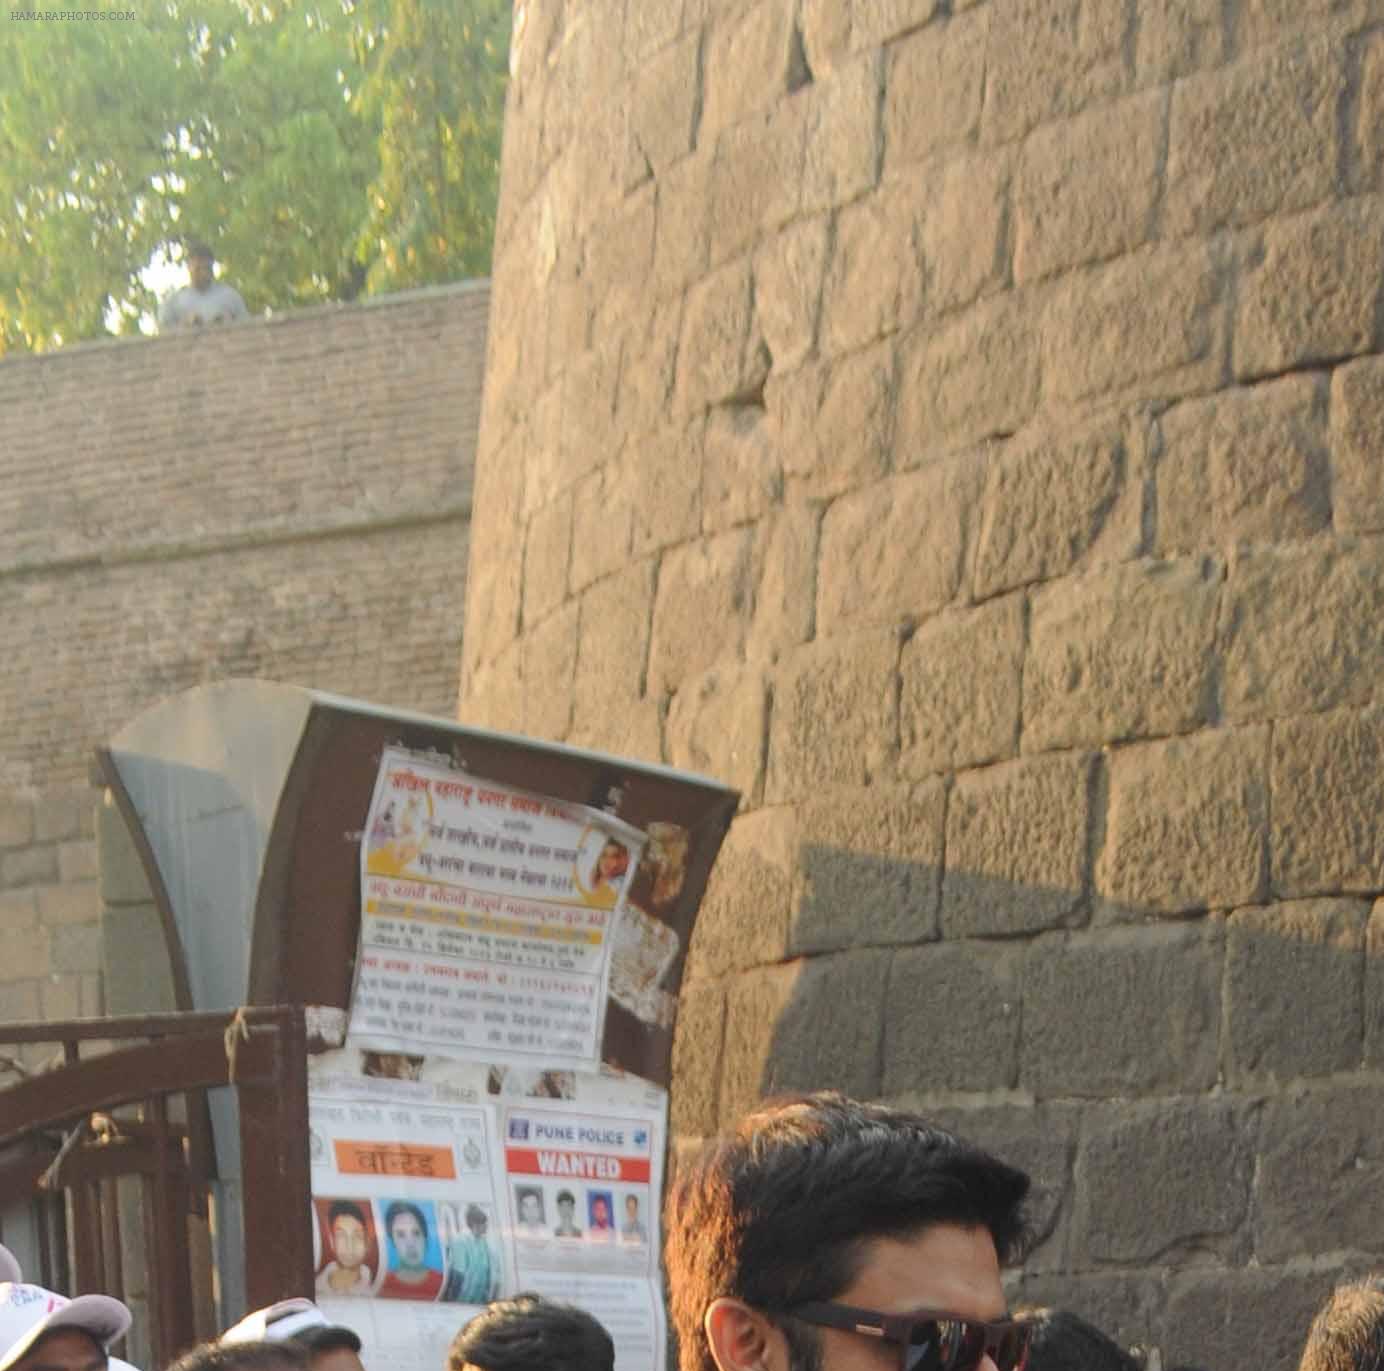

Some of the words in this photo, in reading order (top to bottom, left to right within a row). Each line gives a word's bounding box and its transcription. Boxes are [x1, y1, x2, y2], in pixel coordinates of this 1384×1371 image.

[535, 1125, 575, 1141] PUNE
[578, 1127, 625, 1145] POLICE
[537, 1150, 621, 1179] WANTED
